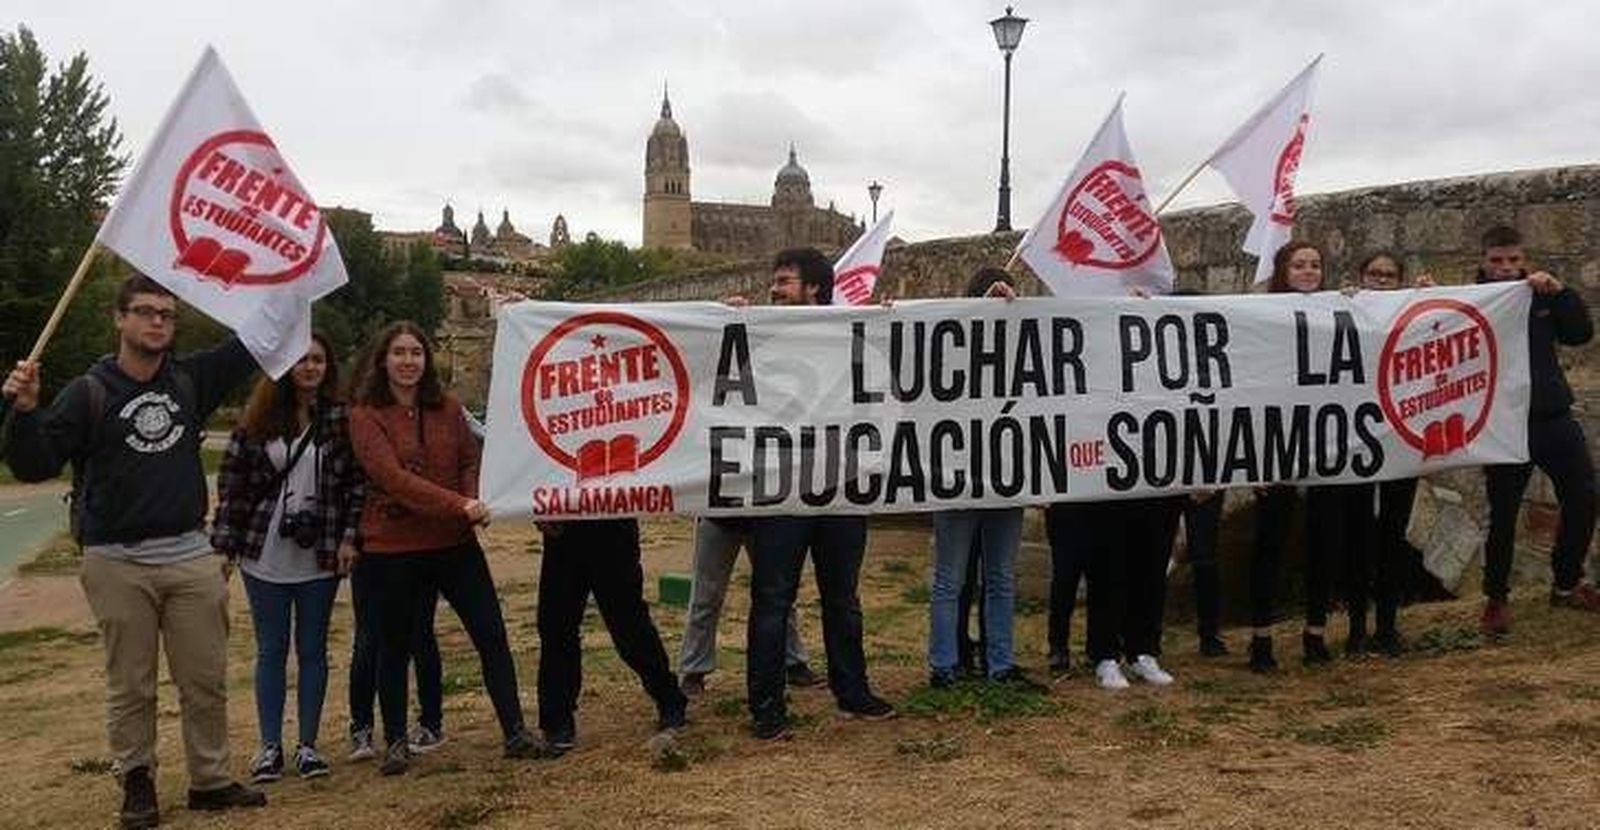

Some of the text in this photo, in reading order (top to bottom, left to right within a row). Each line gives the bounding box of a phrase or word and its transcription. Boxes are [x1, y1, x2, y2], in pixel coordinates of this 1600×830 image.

[197, 150, 319, 231] FRENTE
[1085, 172, 1158, 242] FRENTE
[183, 194, 307, 262] ESTUDIANTES
[539, 344, 661, 400] FRENTE
[713, 310, 1366, 406] A LUCHAR POR LA
[1392, 325, 1480, 386] FRENTE
[546, 392, 674, 434] ESTUDIANTES
[1398, 370, 1488, 420] ESTUDIANTES
[708, 392, 1386, 509] EDUCACIÓN QUE SOÑAMOS
[531, 484, 675, 516] SALAMANCA
